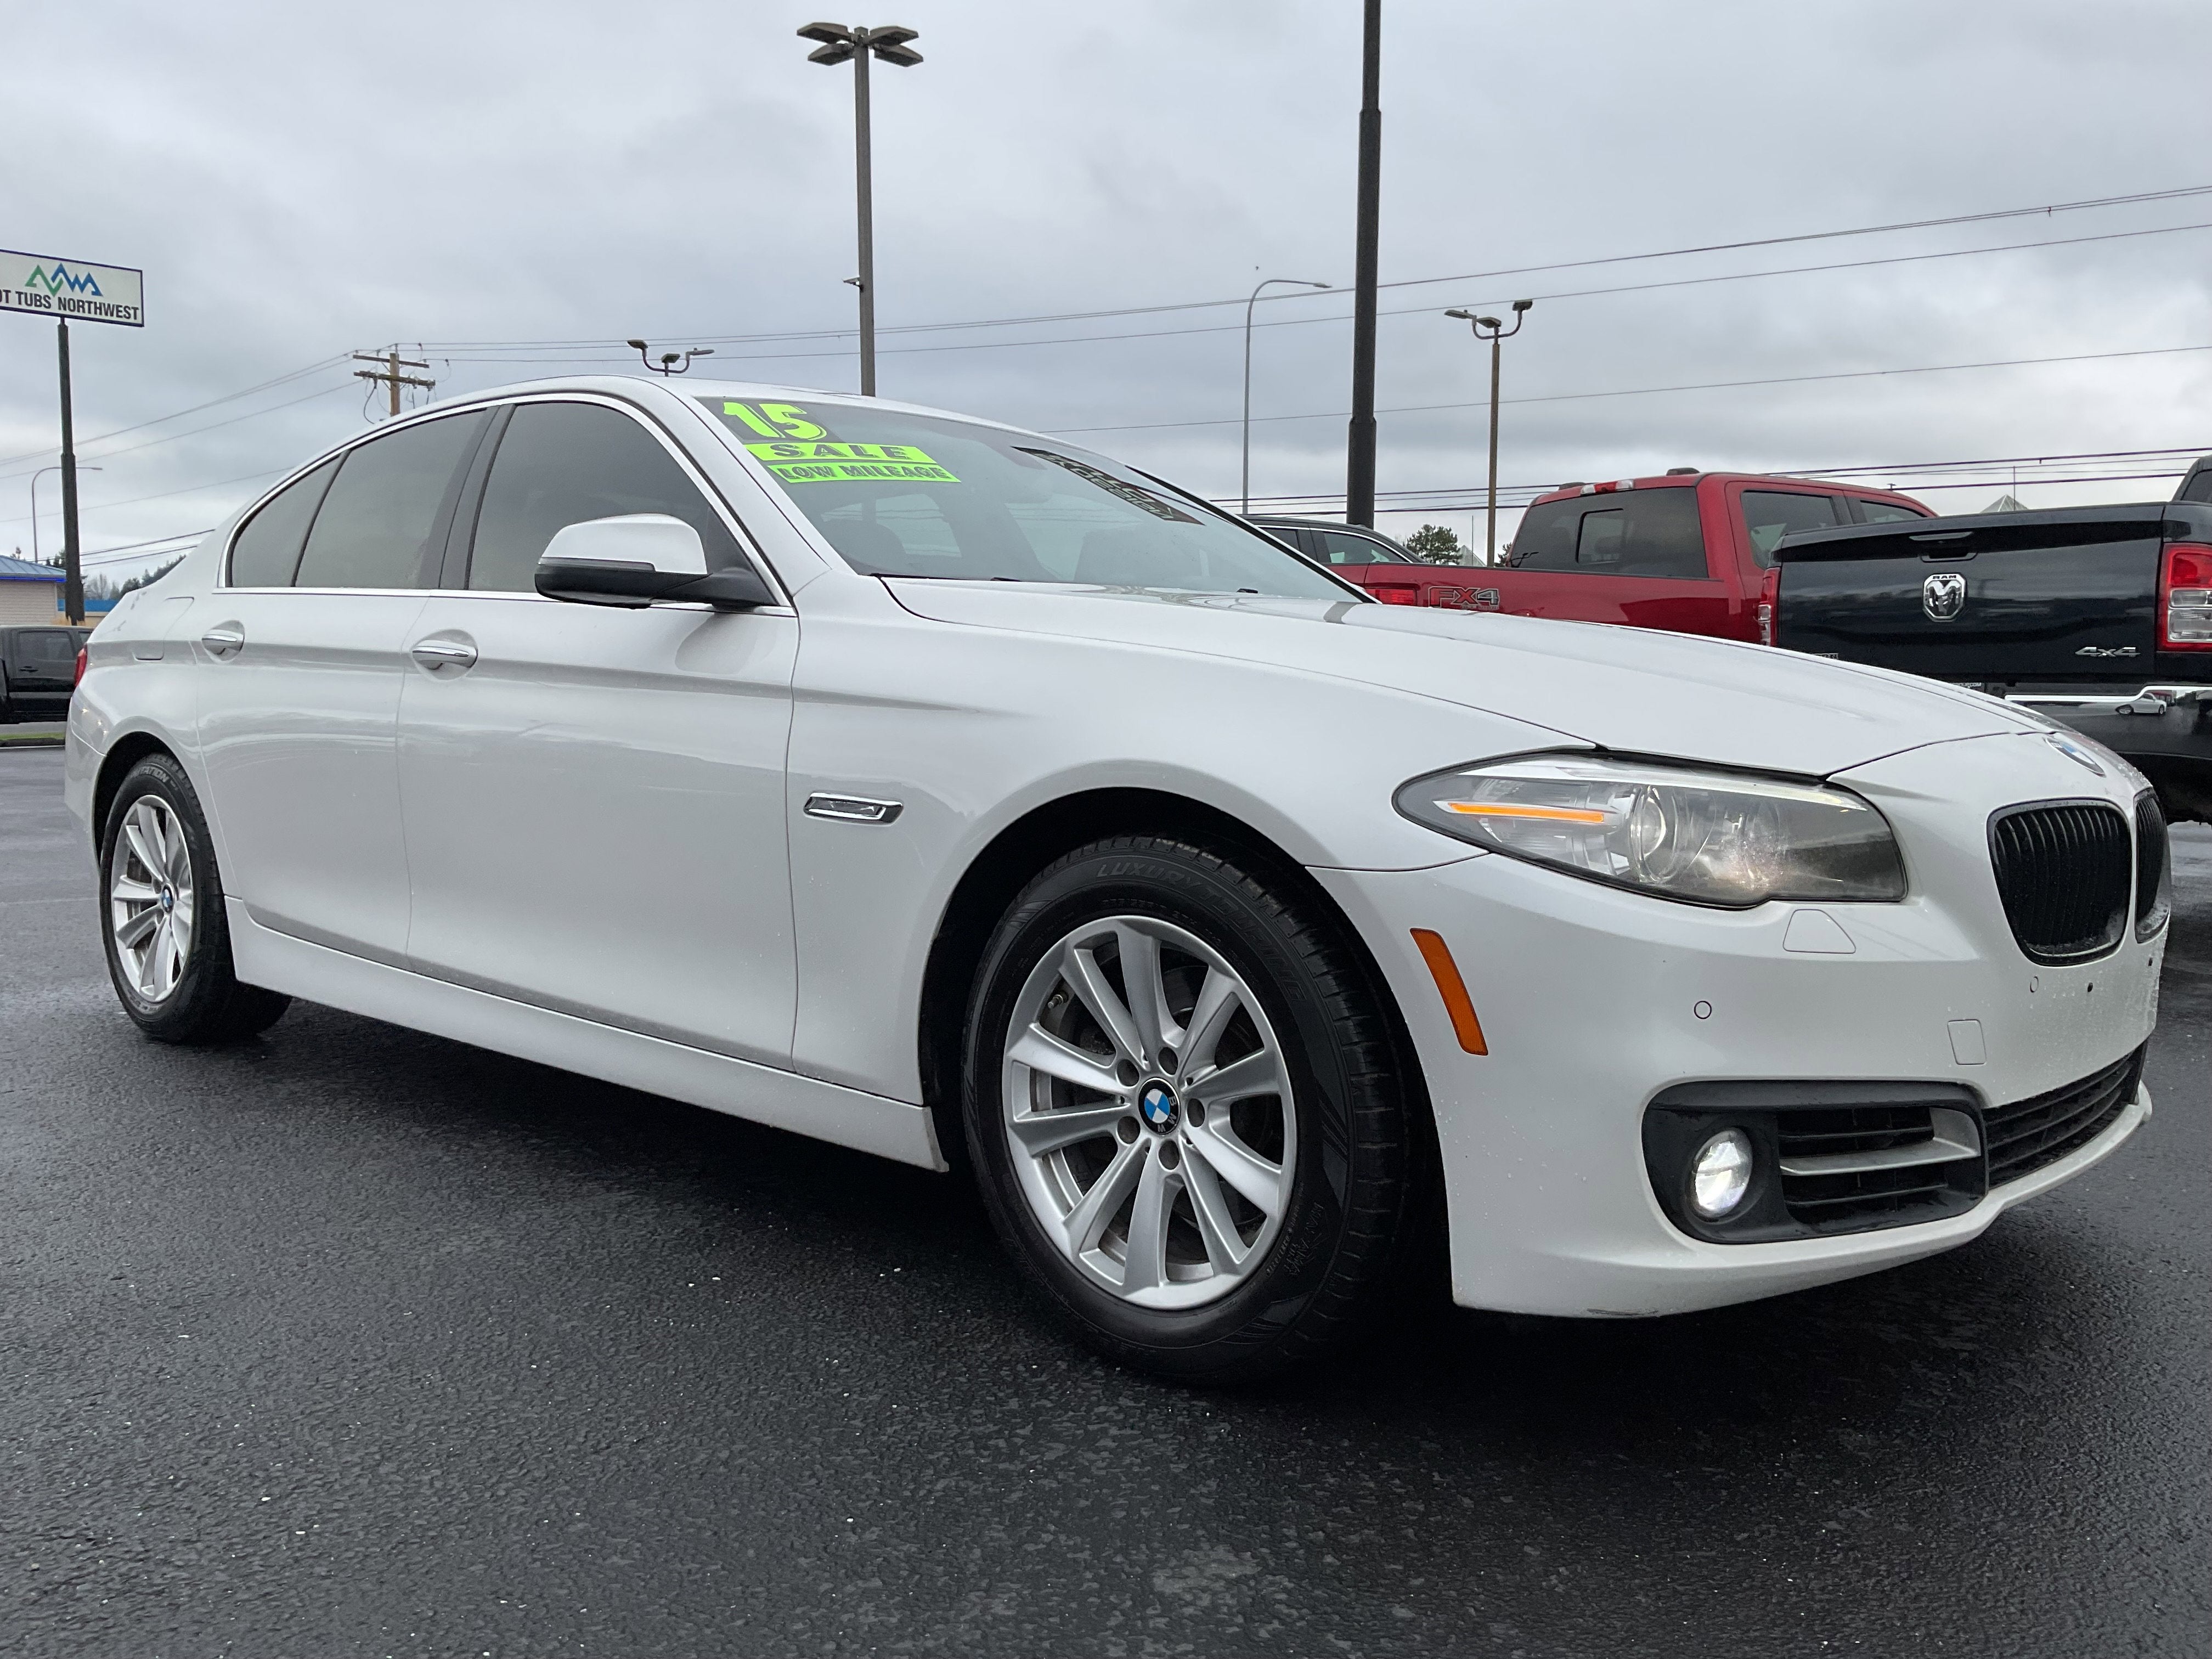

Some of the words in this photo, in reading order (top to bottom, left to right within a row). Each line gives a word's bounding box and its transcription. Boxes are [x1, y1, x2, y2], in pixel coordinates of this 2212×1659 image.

[15, 291, 52, 309] TUBS
[58, 297, 139, 320] NORTHWEST
[724, 402, 827, 440] 15
[770, 444, 911, 460] SALE
[777, 466, 836, 479] LOW
[838, 465, 951, 479] MILEAGE
[1428, 586, 1500, 608] FX4
[1096, 862, 1201, 890] LUXURY
[1200, 884, 1308, 1002] TOURING
[1158, 1096, 1177, 1133] BMW
